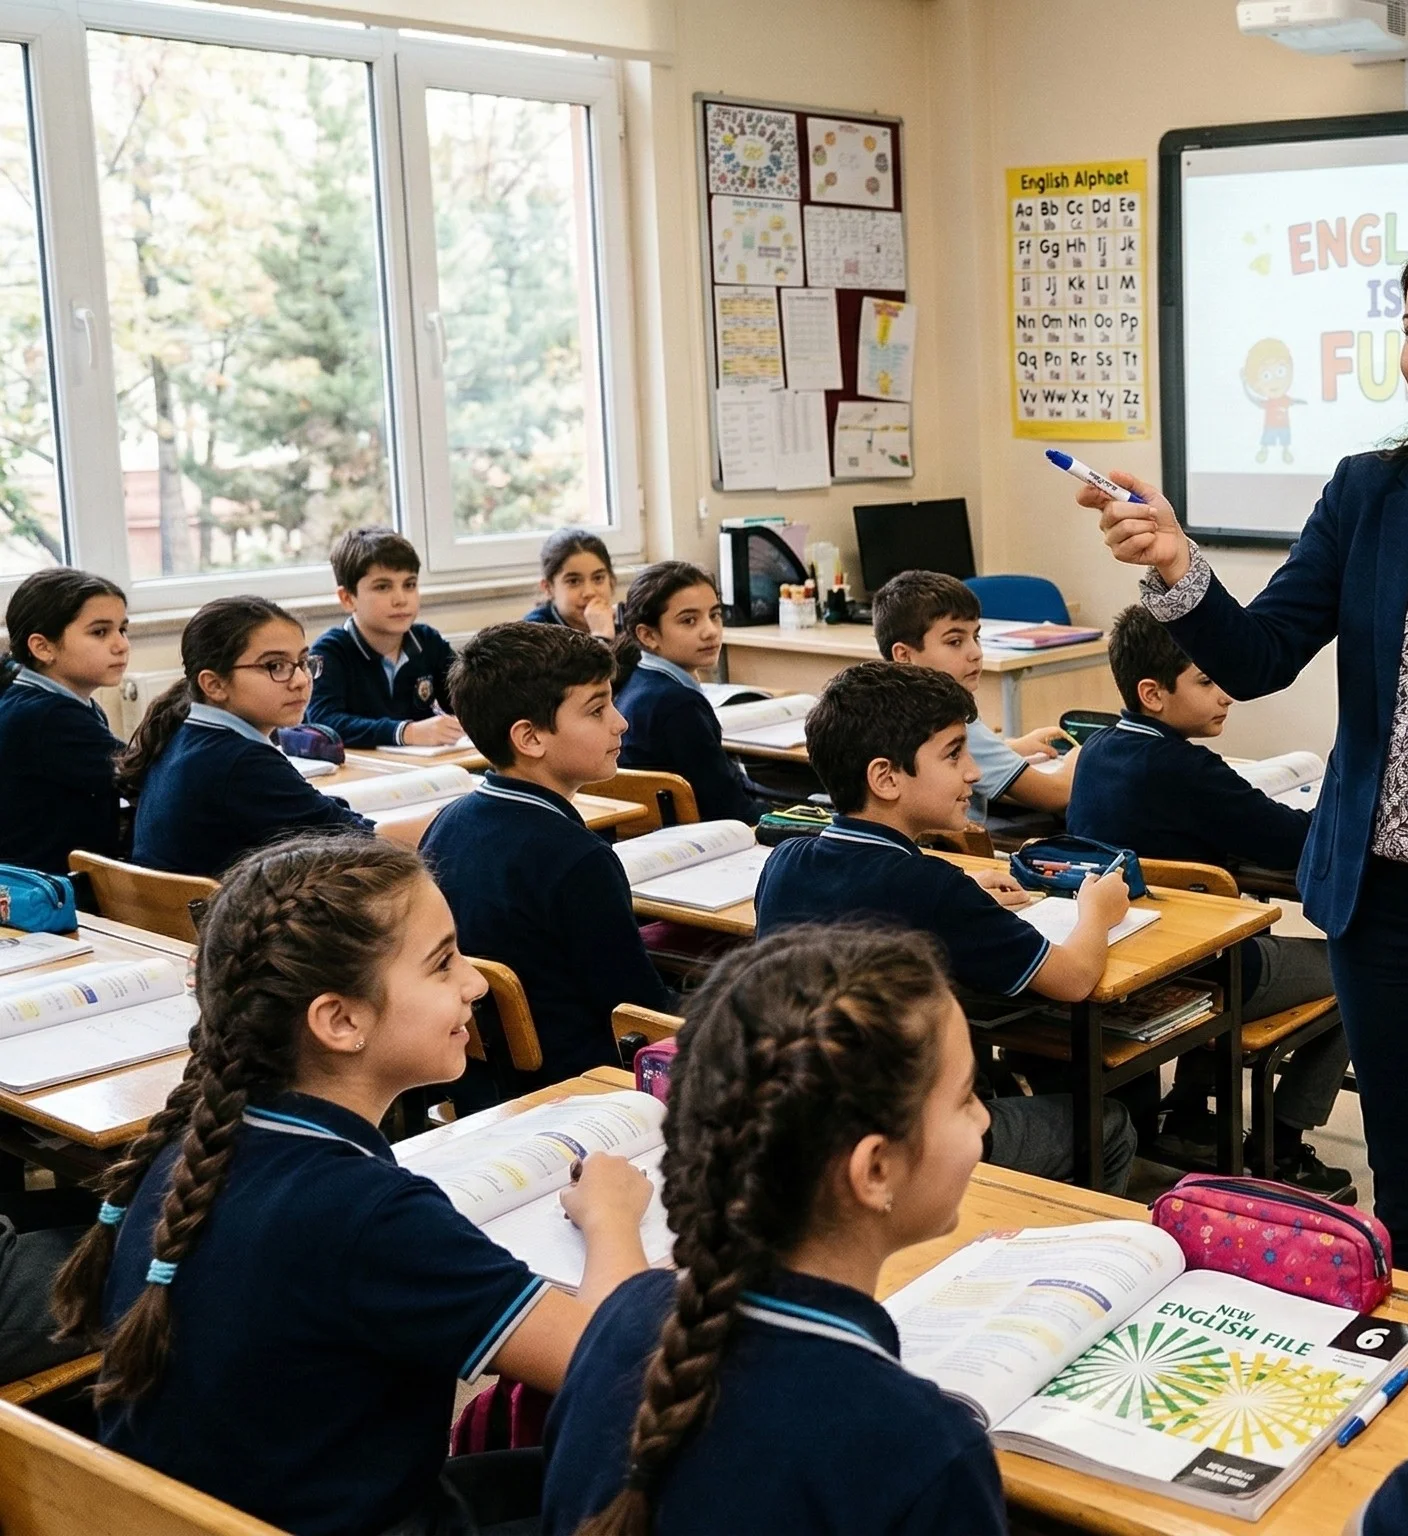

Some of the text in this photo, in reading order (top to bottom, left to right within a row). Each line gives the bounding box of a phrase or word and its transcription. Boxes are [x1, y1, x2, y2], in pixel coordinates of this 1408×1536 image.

[1021, 172, 1069, 194] English
[1016, 198, 1136, 217] Aa Bb Cc Dd Ee
[1018, 240, 1032, 254] Ff
[1040, 238, 1060, 257] Gg
[1066, 237, 1086, 252] Hh
[1120, 236, 1135, 252] Jk
[1046, 276, 1056, 295] Jj
[1068, 276, 1084, 291] Kk
[1097, 276, 1108, 290] Ll
[1120, 275, 1135, 290] M
[1366, 278, 1403, 318] IS
[1017, 315, 1035, 329] Nn
[1069, 314, 1086, 328] Nn
[1094, 314, 1112, 328] Oo
[1121, 314, 1138, 332] Pp
[1018, 352, 1037, 369] Qq
[1071, 352, 1087, 366] Rr
[1096, 352, 1112, 366] Ss
[1123, 352, 1138, 366] Tt
[1020, 389, 1139, 408] Vv Ww Xx Yy Zz
[1157, 1302, 1314, 1356] ENGLISH FILE
[1356, 1328, 1390, 1350] 6
